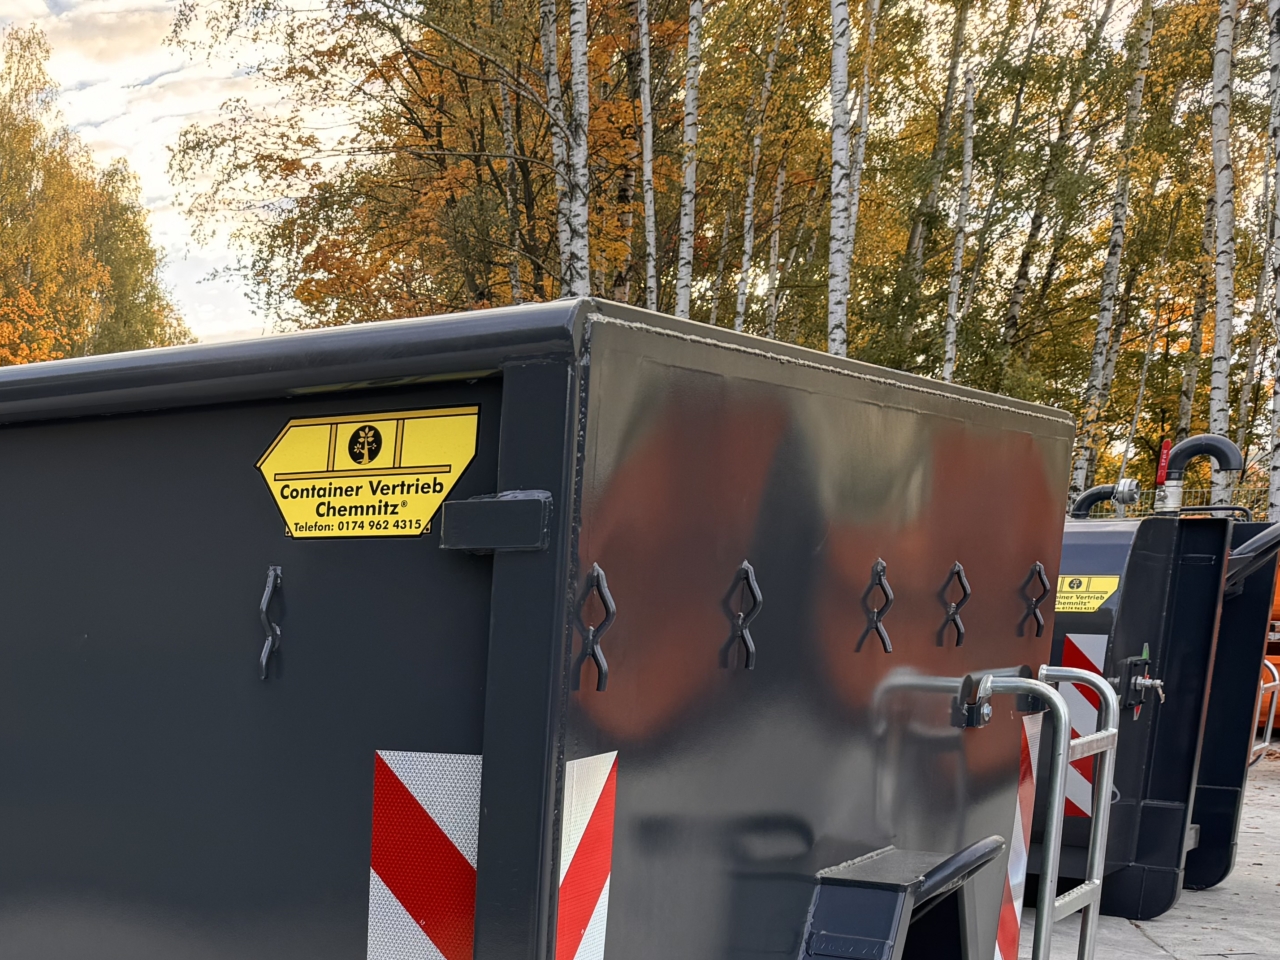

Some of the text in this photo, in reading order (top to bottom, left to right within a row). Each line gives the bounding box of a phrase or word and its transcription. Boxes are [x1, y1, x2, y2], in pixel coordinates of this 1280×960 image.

[280, 477, 444, 500] Container Vertrieb
[293, 519, 422, 532] Telefon: 0174 962 4315
